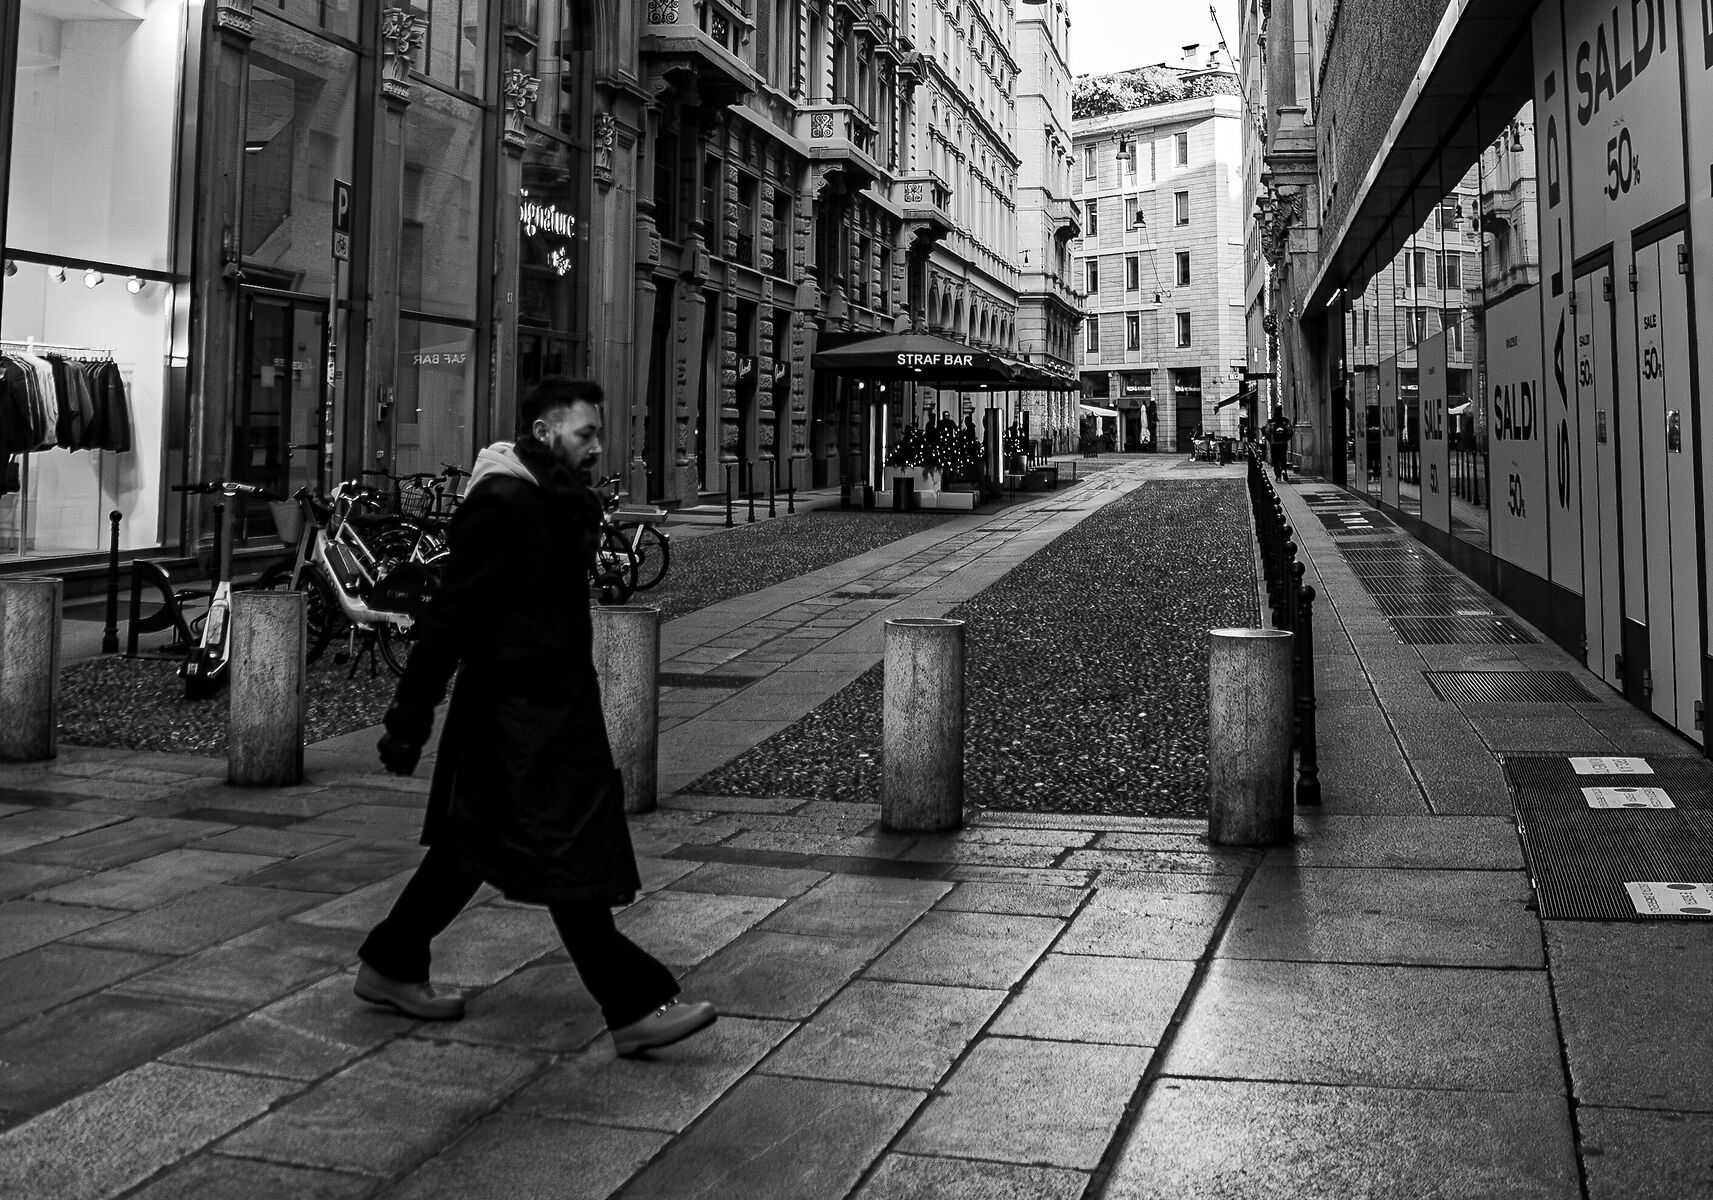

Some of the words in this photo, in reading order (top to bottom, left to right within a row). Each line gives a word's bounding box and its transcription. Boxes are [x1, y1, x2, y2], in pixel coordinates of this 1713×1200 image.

[1603, 126, 1641, 202] -50%
[338, 187, 348, 227] P
[1543, 70, 1569, 513] SALDI
[1643, 313, 1657, 330] SALE
[897, 353, 941, 366] STRAF
[944, 353, 973, 367] BAR
[1424, 398, 1442, 441] SALE
[1494, 379, 1537, 441] SALDI
